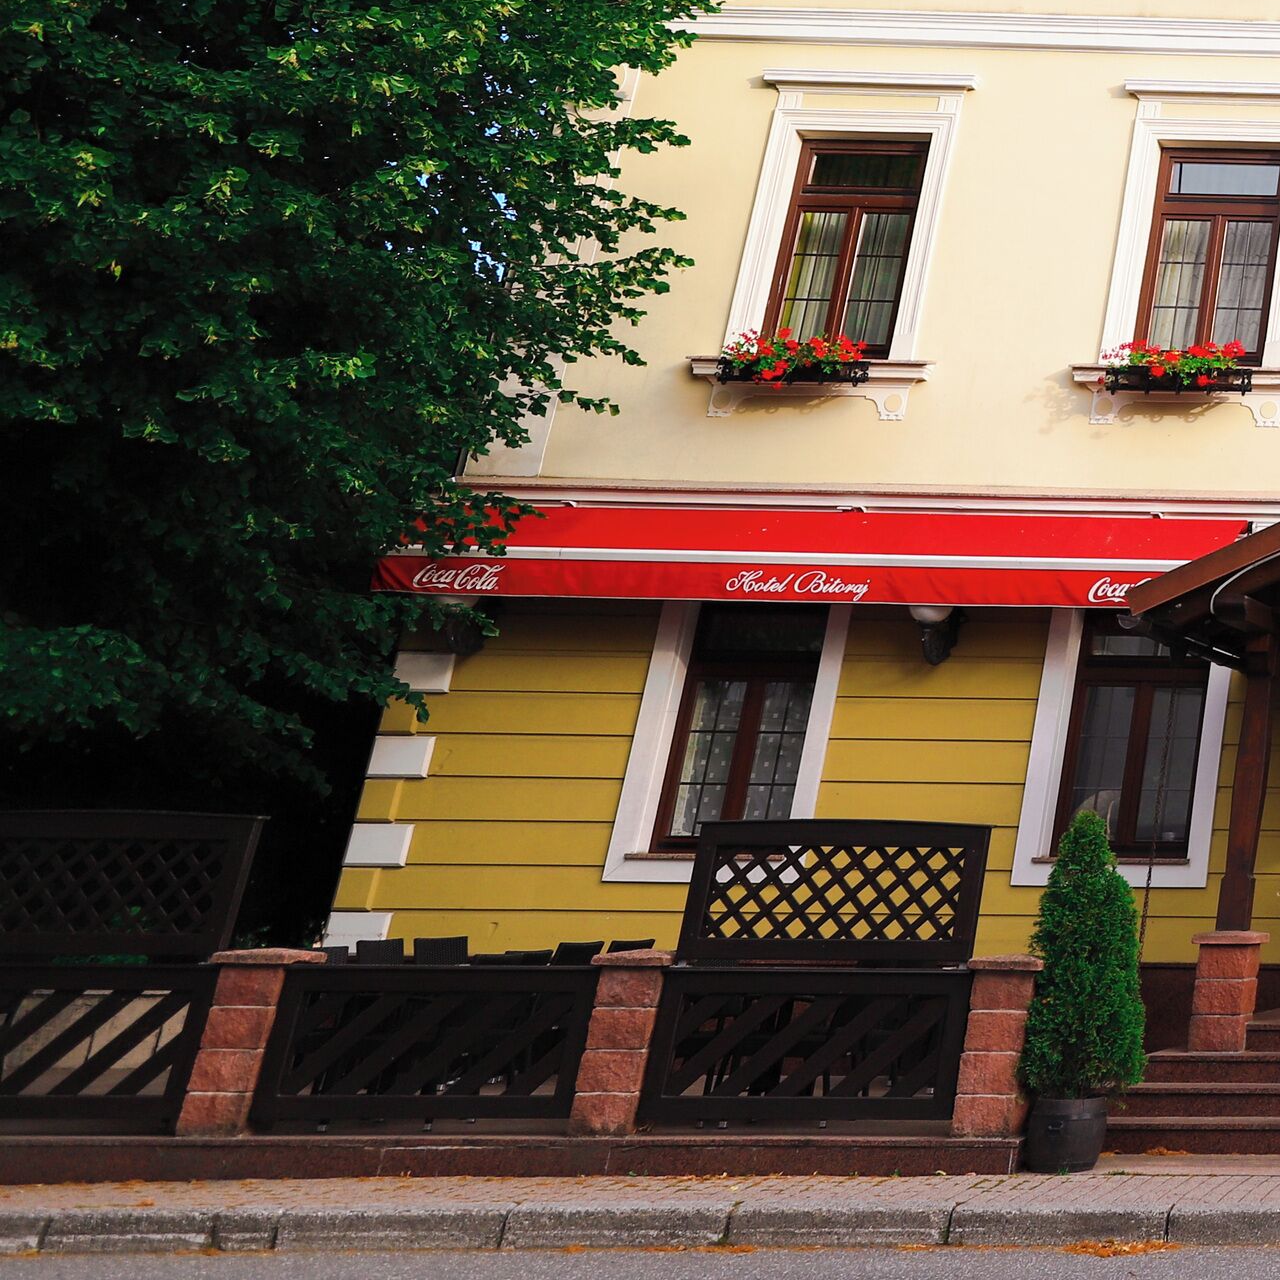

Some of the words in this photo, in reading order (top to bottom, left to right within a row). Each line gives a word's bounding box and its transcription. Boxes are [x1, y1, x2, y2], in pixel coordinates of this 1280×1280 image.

[412, 563, 506, 590] Coca-Cola
[725, 570, 795, 593] Hotel
[793, 570, 871, 602] Bitoraj
